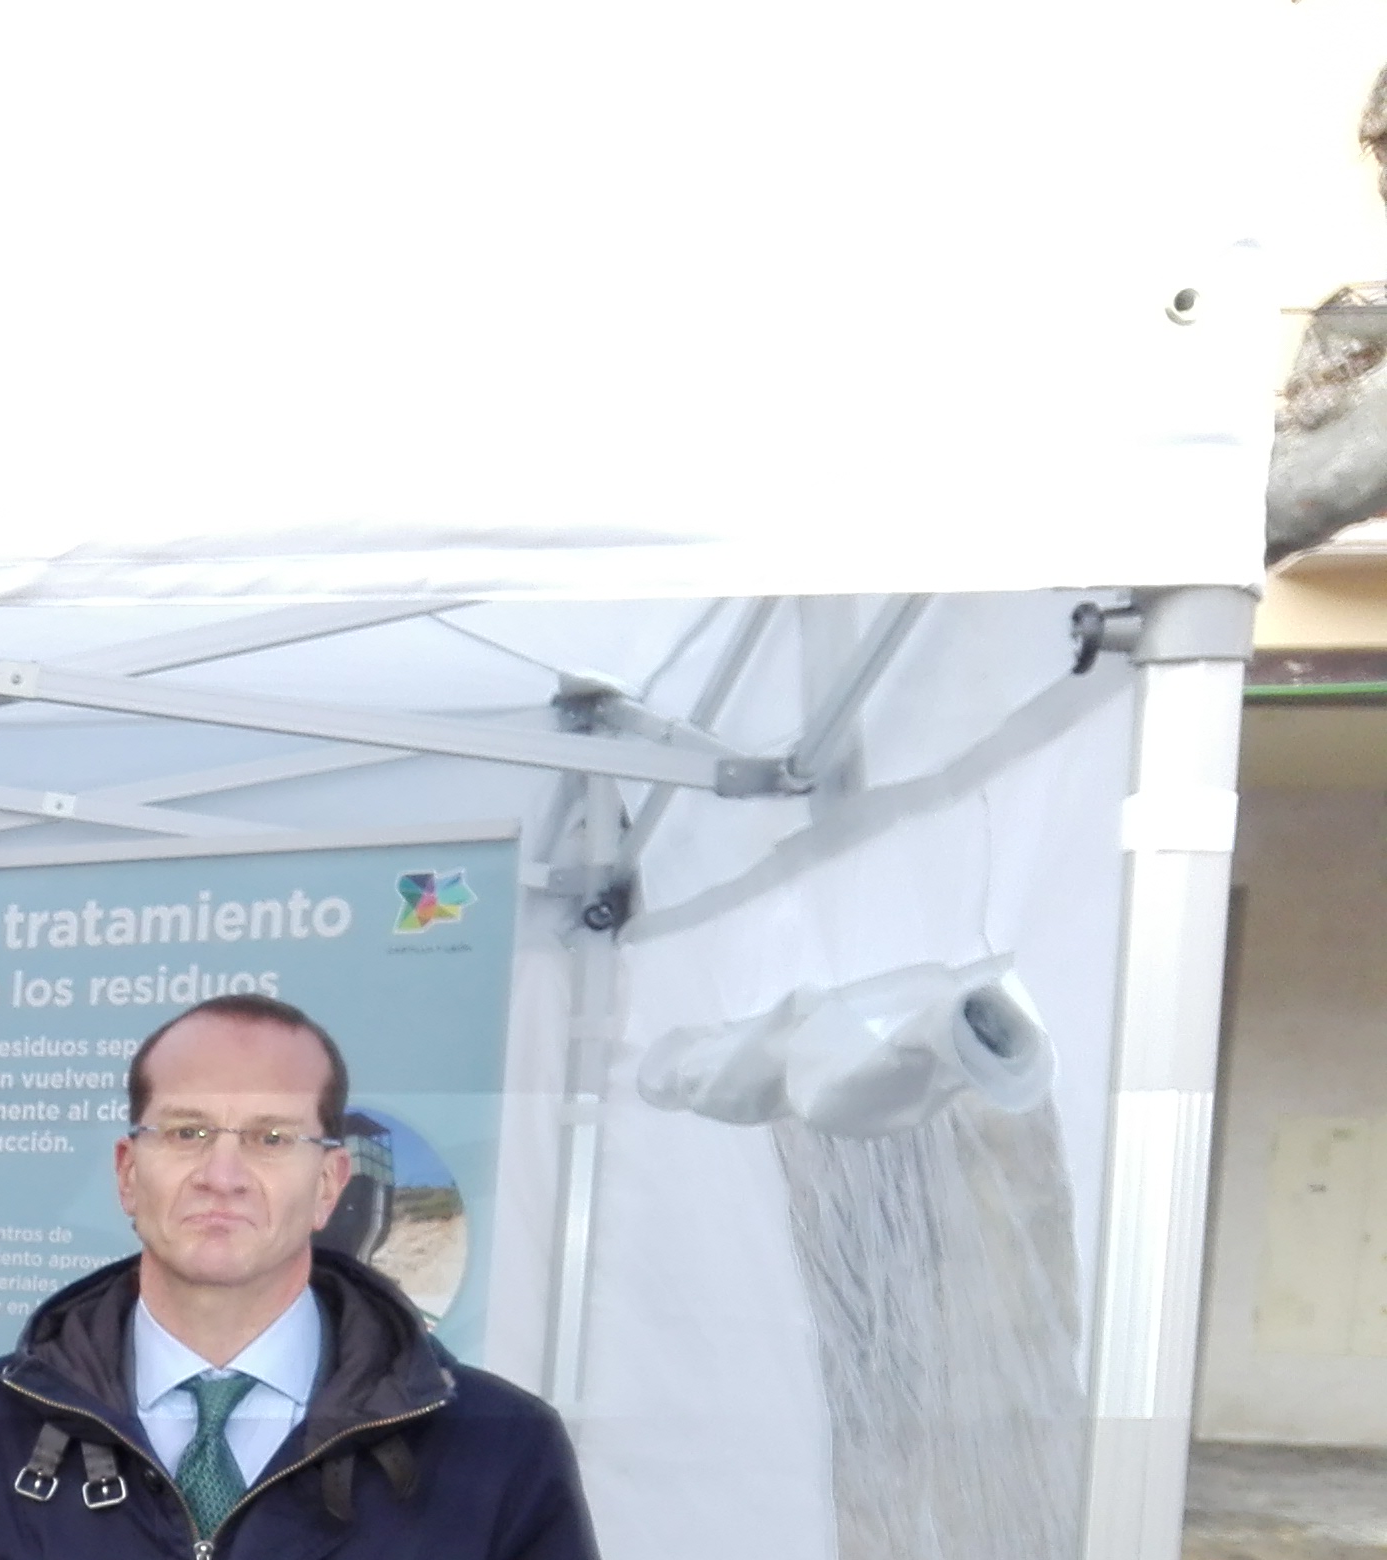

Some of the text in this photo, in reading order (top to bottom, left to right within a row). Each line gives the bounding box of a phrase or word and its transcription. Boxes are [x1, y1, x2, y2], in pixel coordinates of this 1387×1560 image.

[3, 890, 353, 949] tratamiento
[13, 970, 74, 1008] los
[89, 965, 280, 1006] residuos
[21, 1067, 115, 1089] vuelven
[67, 1101, 89, 1121] al
[48, 1227, 73, 1243] de
[6, 1301, 29, 1315] en
